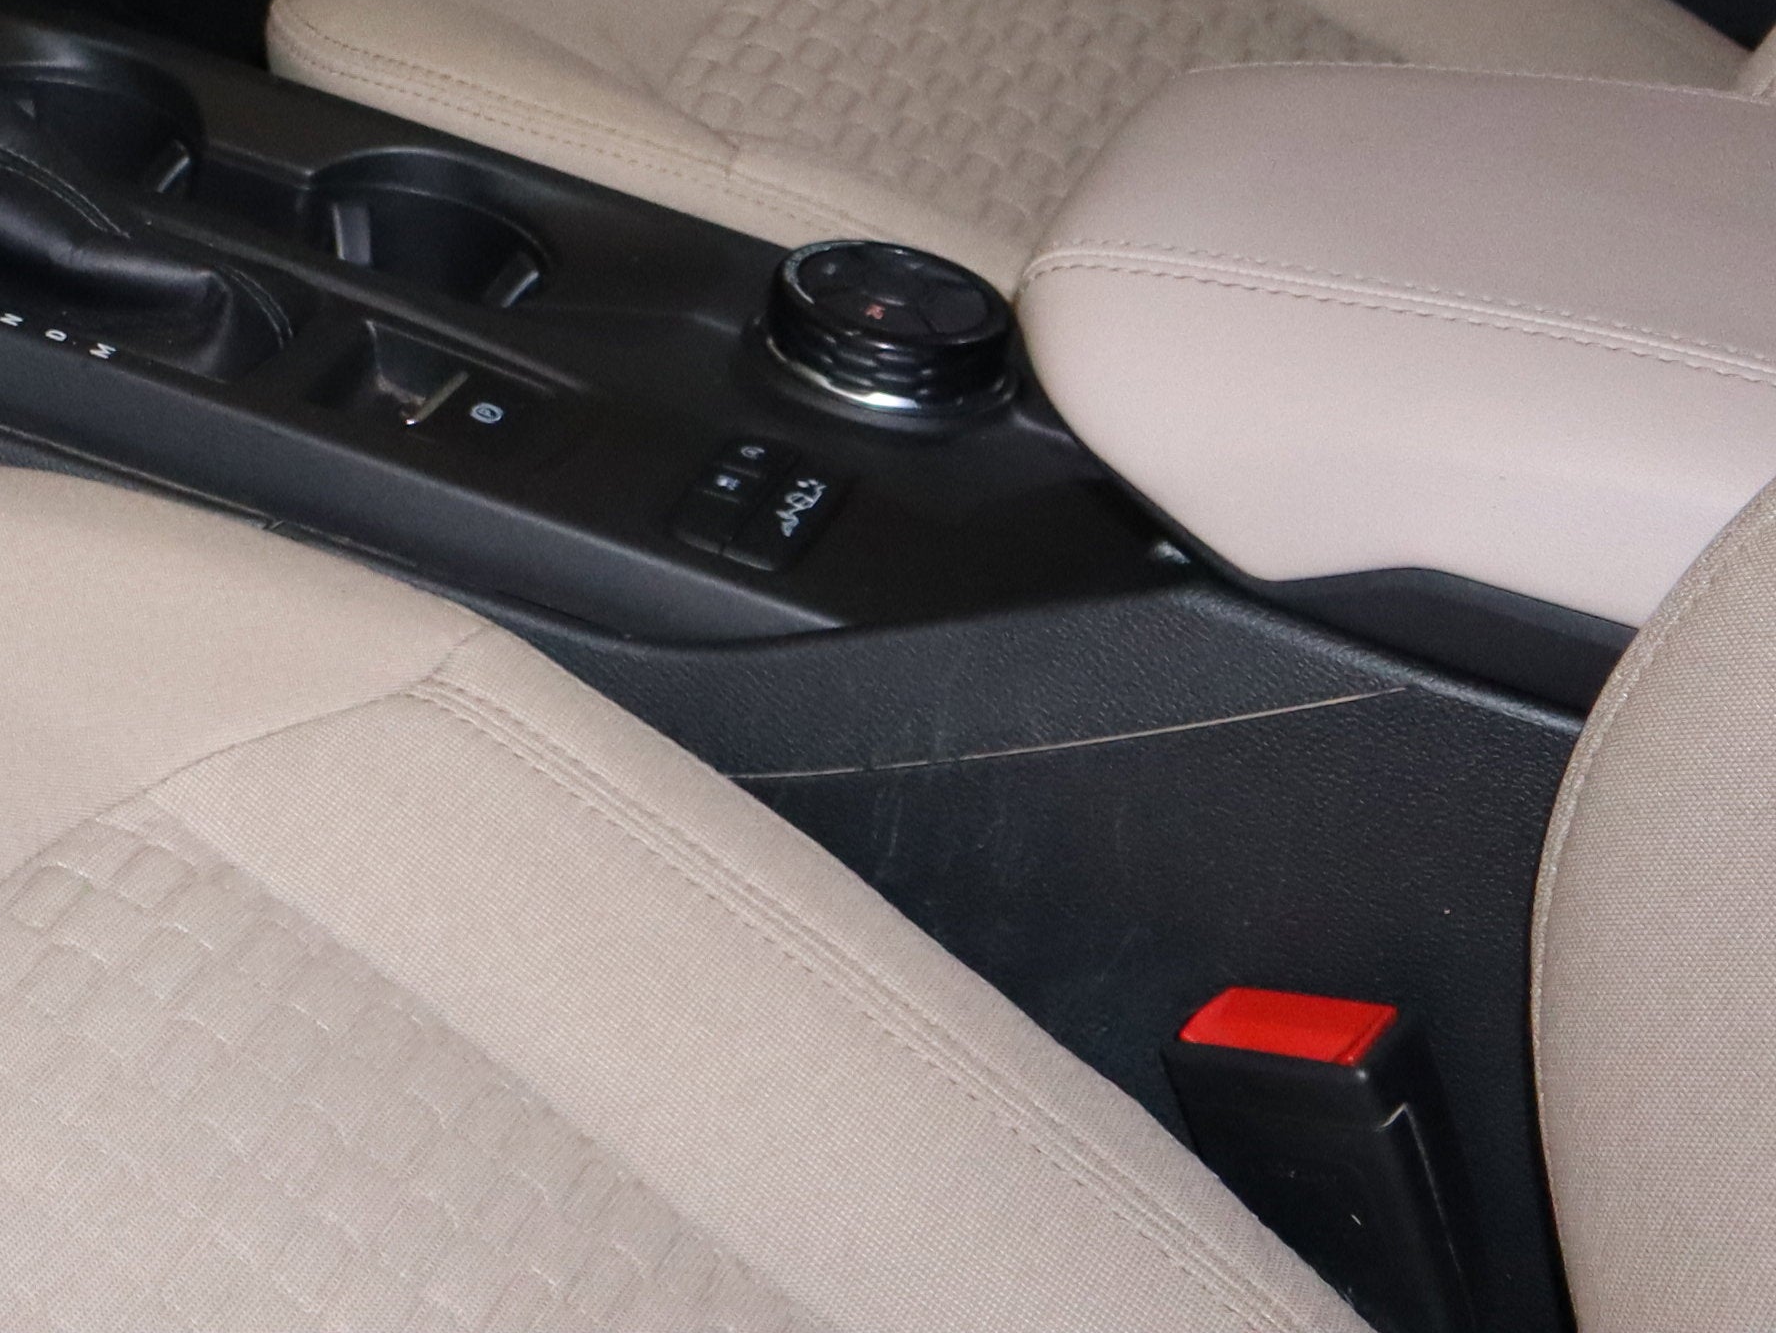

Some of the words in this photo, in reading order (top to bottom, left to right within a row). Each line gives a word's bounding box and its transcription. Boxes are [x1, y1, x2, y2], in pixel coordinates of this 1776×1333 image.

[0, 312, 24, 327] N
[45, 328, 68, 342] D
[89, 342, 117, 359] M
